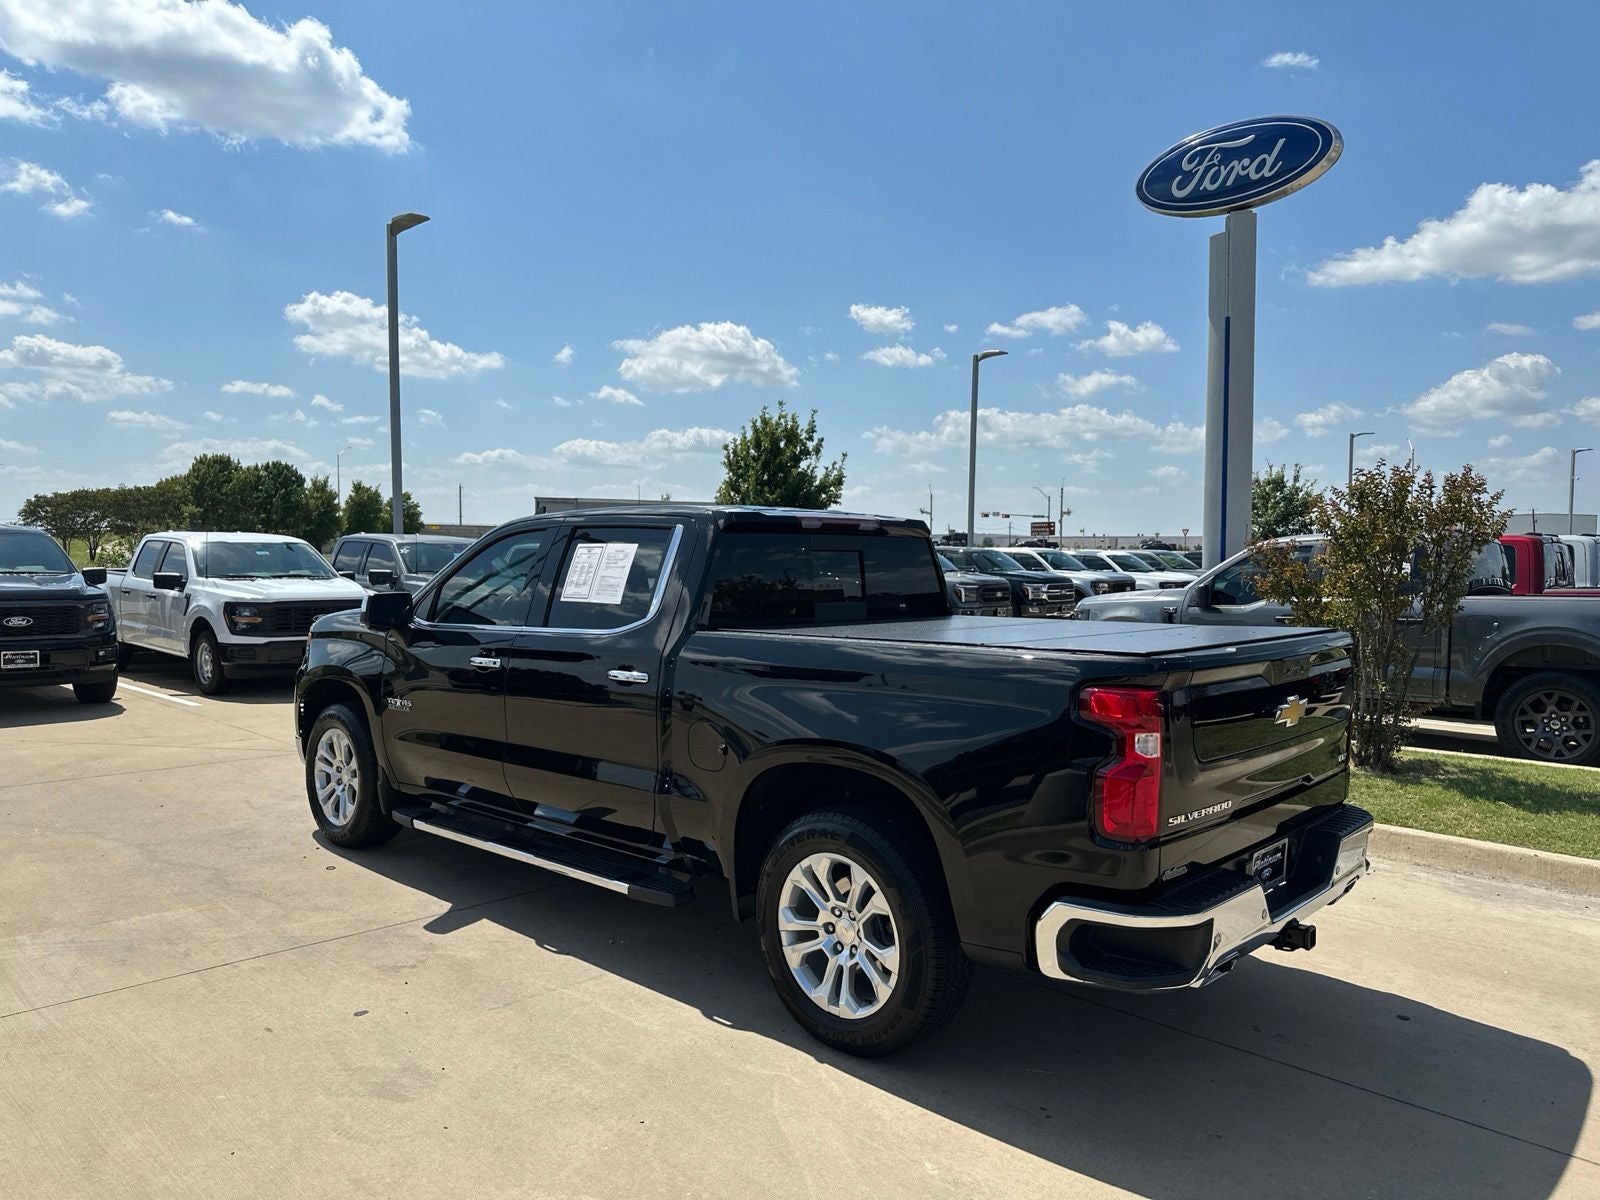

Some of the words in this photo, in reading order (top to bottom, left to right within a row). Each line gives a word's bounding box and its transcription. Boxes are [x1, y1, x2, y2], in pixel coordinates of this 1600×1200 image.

[1171, 134, 1286, 198] Ford
[8, 617, 28, 625] Ford
[1168, 800, 1232, 827] SILVERADO
